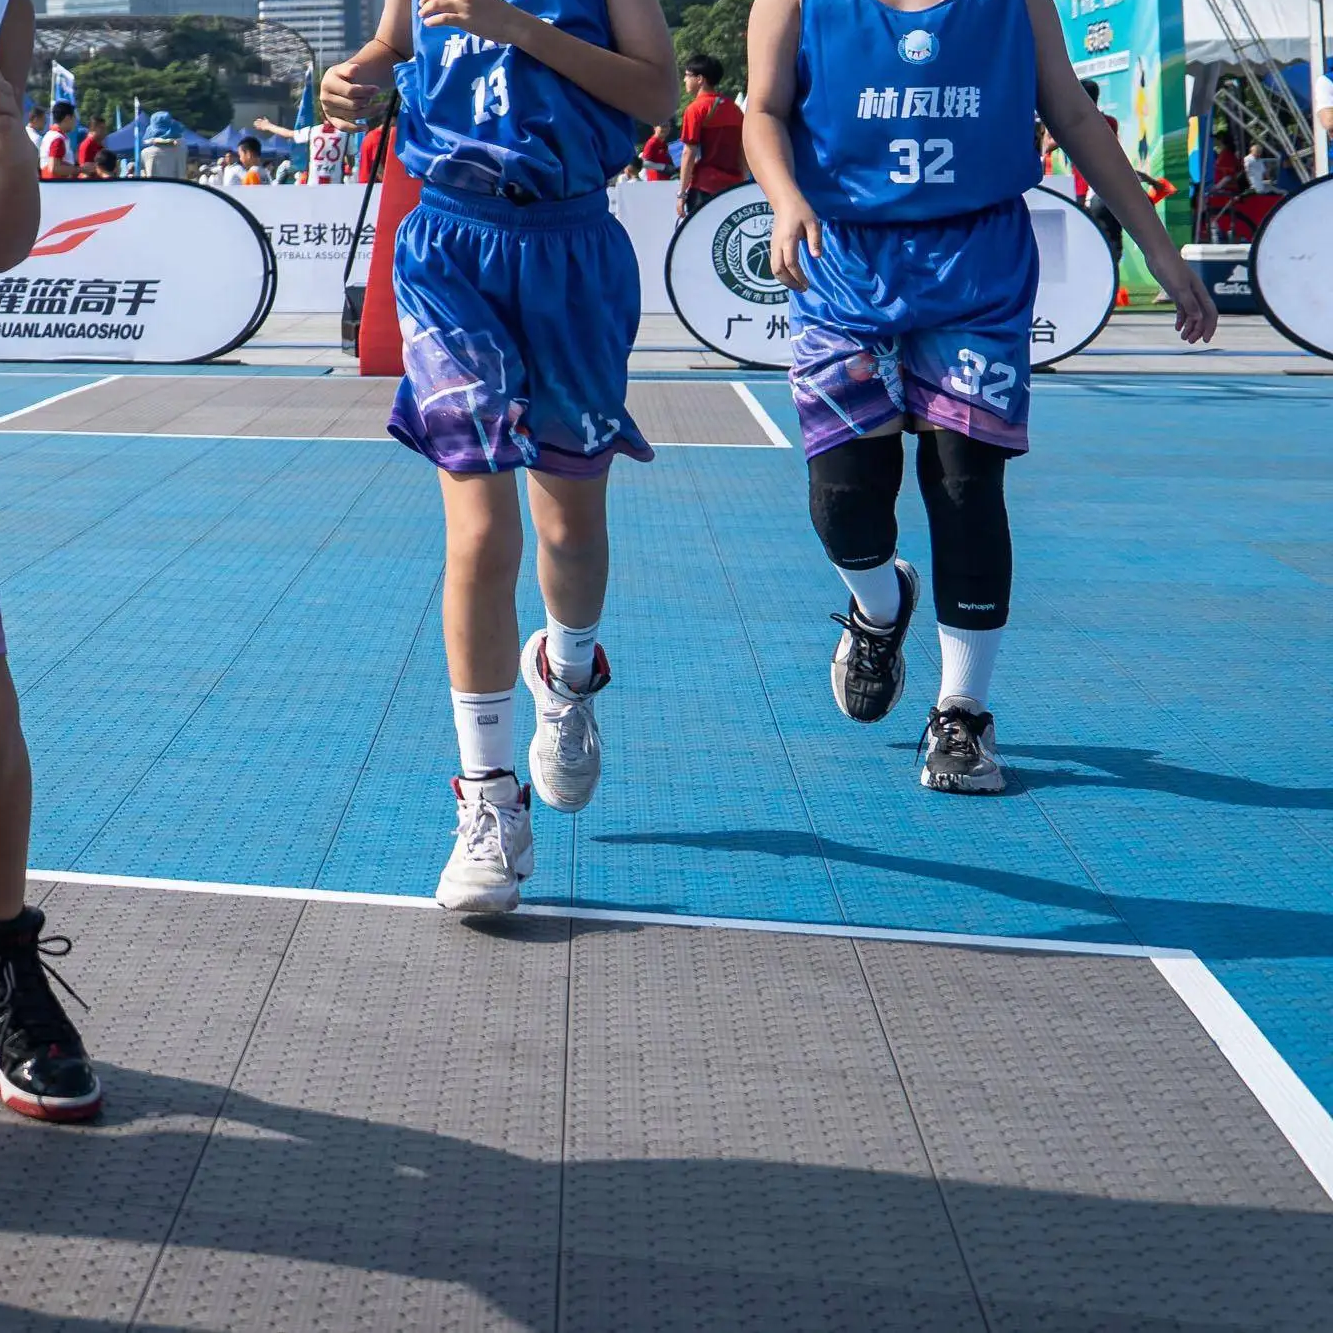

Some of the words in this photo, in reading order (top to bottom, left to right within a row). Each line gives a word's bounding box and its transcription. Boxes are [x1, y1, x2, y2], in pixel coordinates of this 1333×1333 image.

[471, 65, 511, 125] 13
[857, 86, 981, 120] 林凤娥
[313, 136, 342, 163] 23
[889, 138, 956, 185] 32
[716, 223, 733, 275] GUANGZHOU
[1028, 317, 1057, 344] 台
[950, 347, 1018, 411] 32
